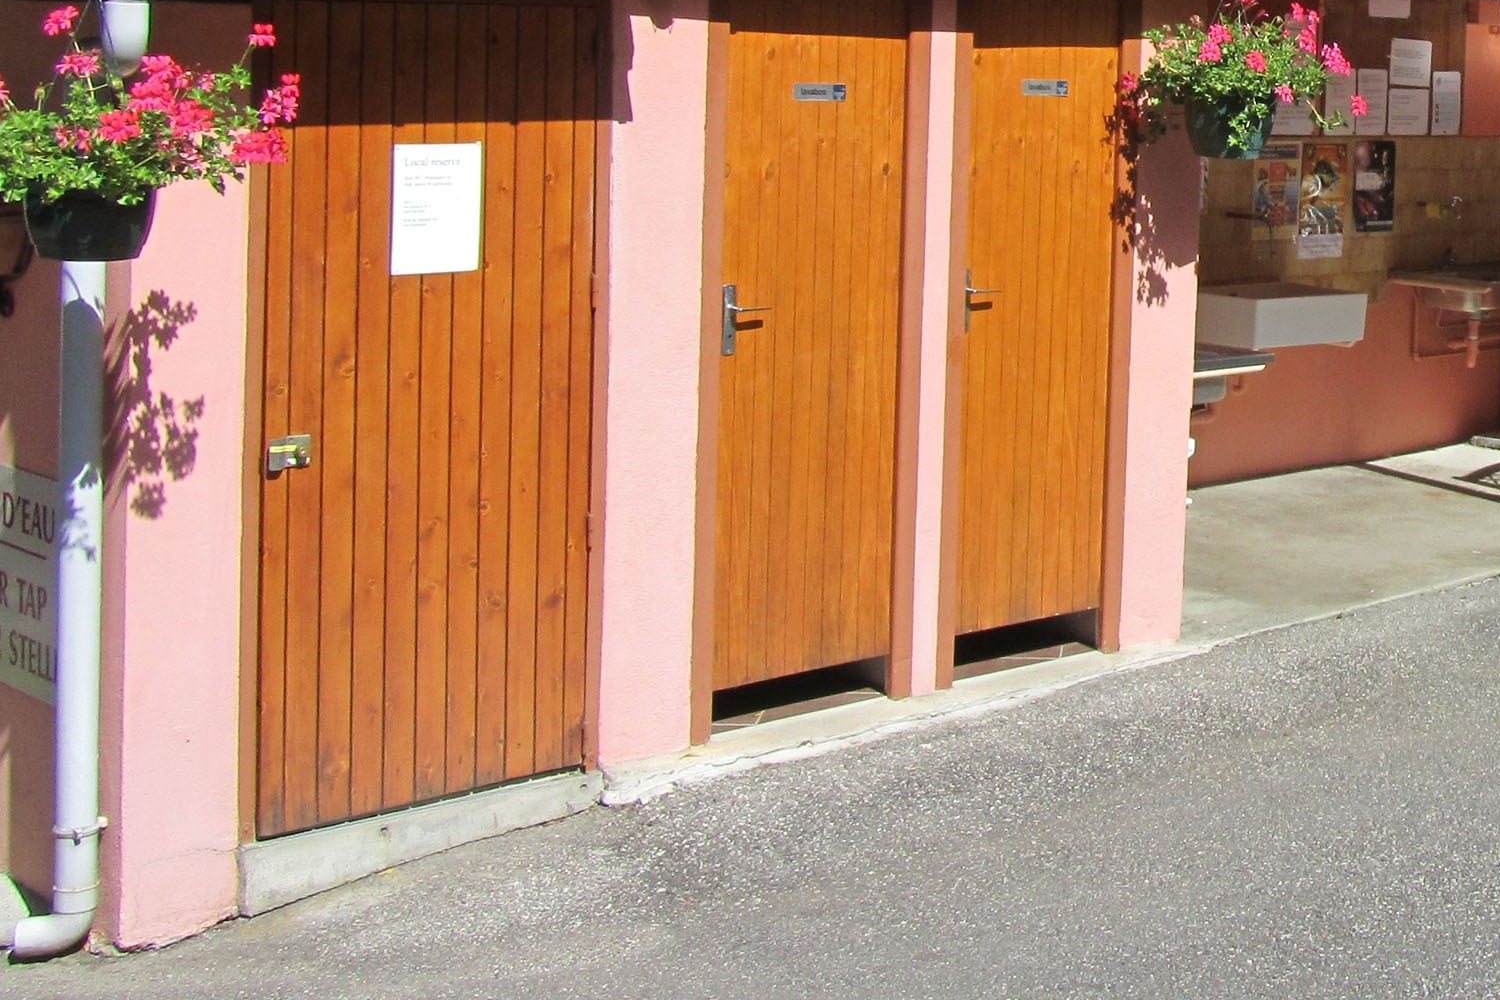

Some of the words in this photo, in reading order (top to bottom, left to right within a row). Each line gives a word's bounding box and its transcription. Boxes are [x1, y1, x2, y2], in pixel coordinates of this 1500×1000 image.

[404, 156, 429, 167] Local
[2, 491, 55, 545] D'EAU
[16, 576, 48, 622] TAP
[9, 629, 57, 684] STELL
